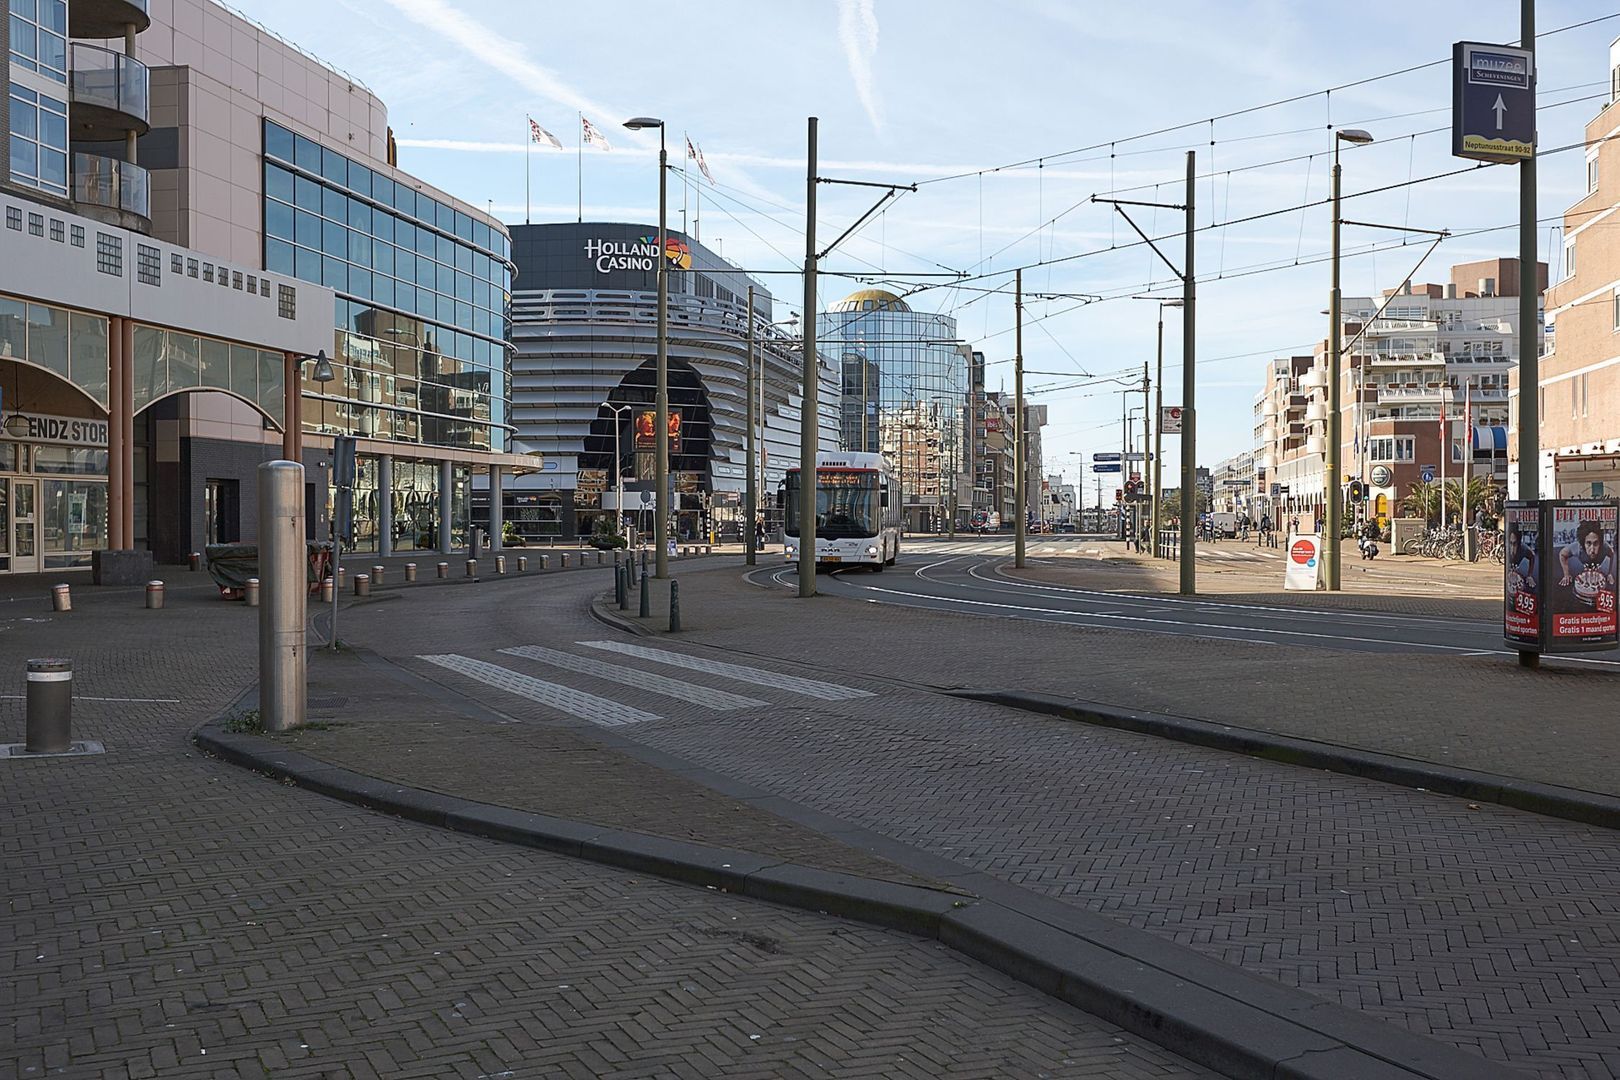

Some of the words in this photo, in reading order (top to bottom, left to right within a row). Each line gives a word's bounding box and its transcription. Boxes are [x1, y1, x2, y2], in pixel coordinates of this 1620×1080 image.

[1477, 58, 1521, 70] muzee
[1465, 141, 1514, 152] Neptunusstraat
[584, 239, 660, 258] HOLLAND
[596, 255, 653, 273] CASINO
[1556, 509, 1575, 521] FIT
[1578, 508, 1598, 521] FOR
[1518, 594, 1534, 610] 9,95
[1600, 593, 1613, 608] 9,95
[1560, 616, 1580, 625] Gratis
[1560, 625, 1580, 634] Gratis
